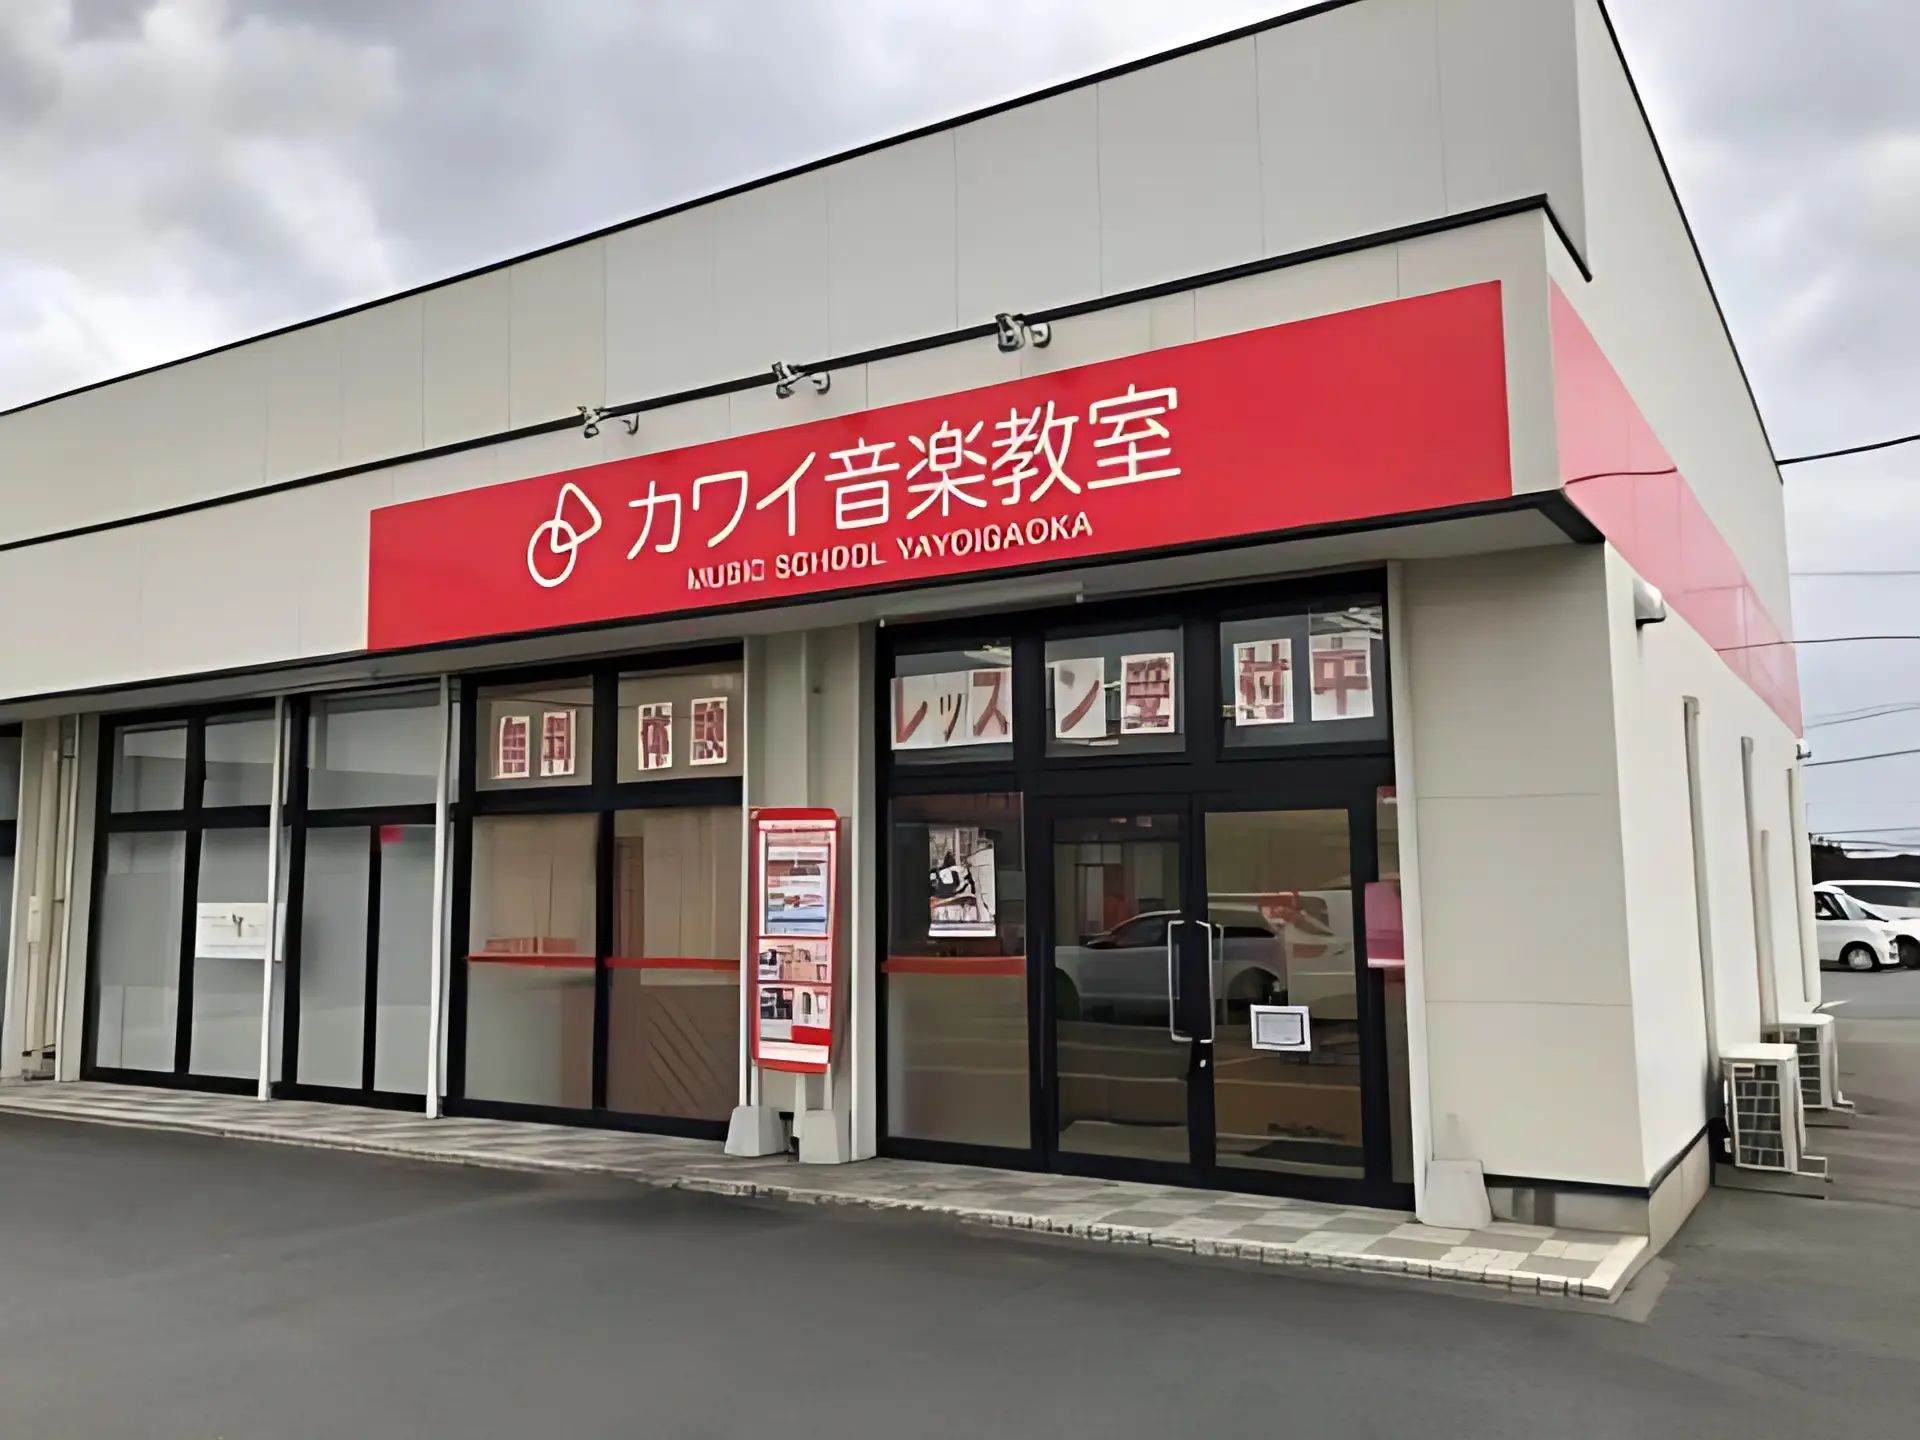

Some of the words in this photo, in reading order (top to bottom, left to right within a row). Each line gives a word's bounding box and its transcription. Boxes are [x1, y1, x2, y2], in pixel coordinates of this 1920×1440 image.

[627, 384, 1182, 559] カワイ音楽教室
[775, 541, 888, 579] SCHOOL
[896, 511, 1094, 560] YAYOIGAOKA
